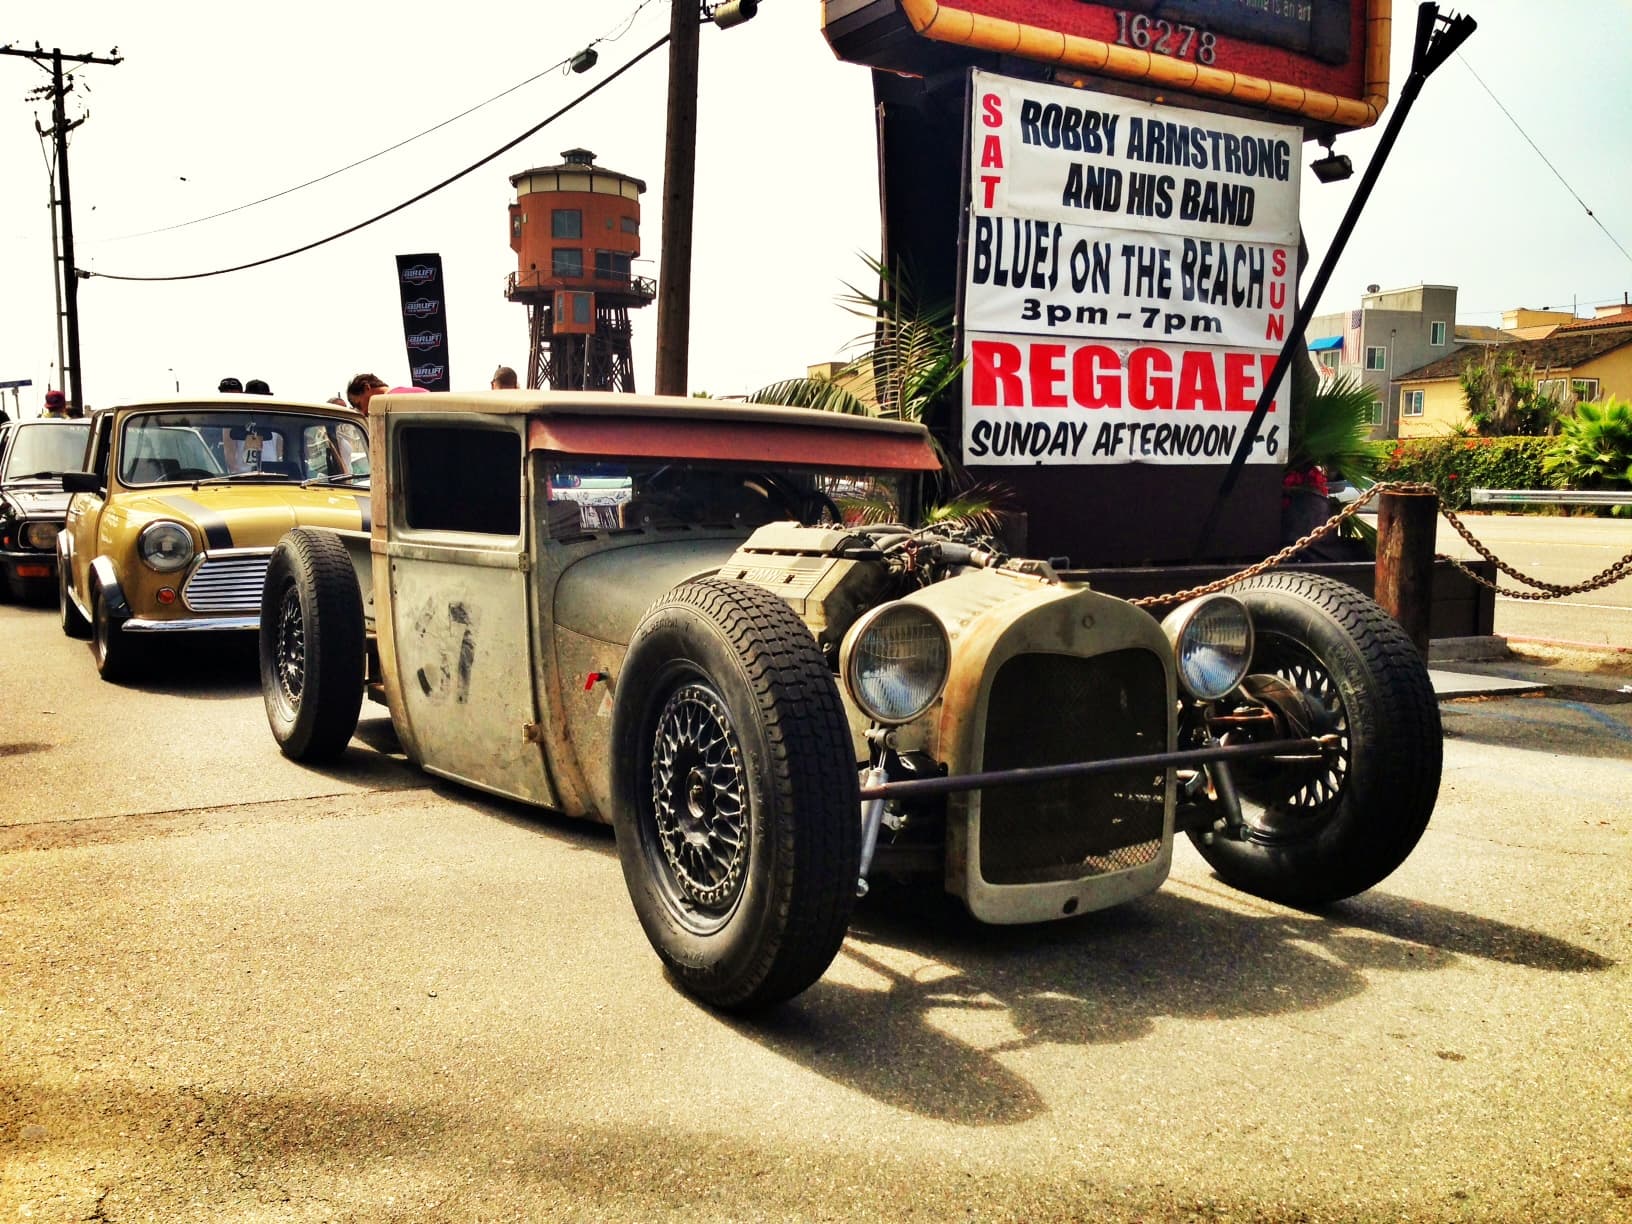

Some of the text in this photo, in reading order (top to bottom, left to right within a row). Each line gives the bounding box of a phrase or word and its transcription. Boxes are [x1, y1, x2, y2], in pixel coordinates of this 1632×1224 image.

[1116, 11, 1217, 65] 16278
[980, 93, 1004, 209] SAT
[1021, 99, 1291, 182] ROBBY ARMSTRONG
[1062, 162, 1255, 227] AND HIS BAND
[973, 216, 1265, 309] BLUES ON THE BEACH
[1265, 249, 1287, 342] SUN
[1021, 298, 1108, 327] 3pm
[1140, 306, 1223, 334] 7pm
[968, 419, 1088, 457] SUNDAY
[1092, 421, 1237, 457] AFTERNOON
